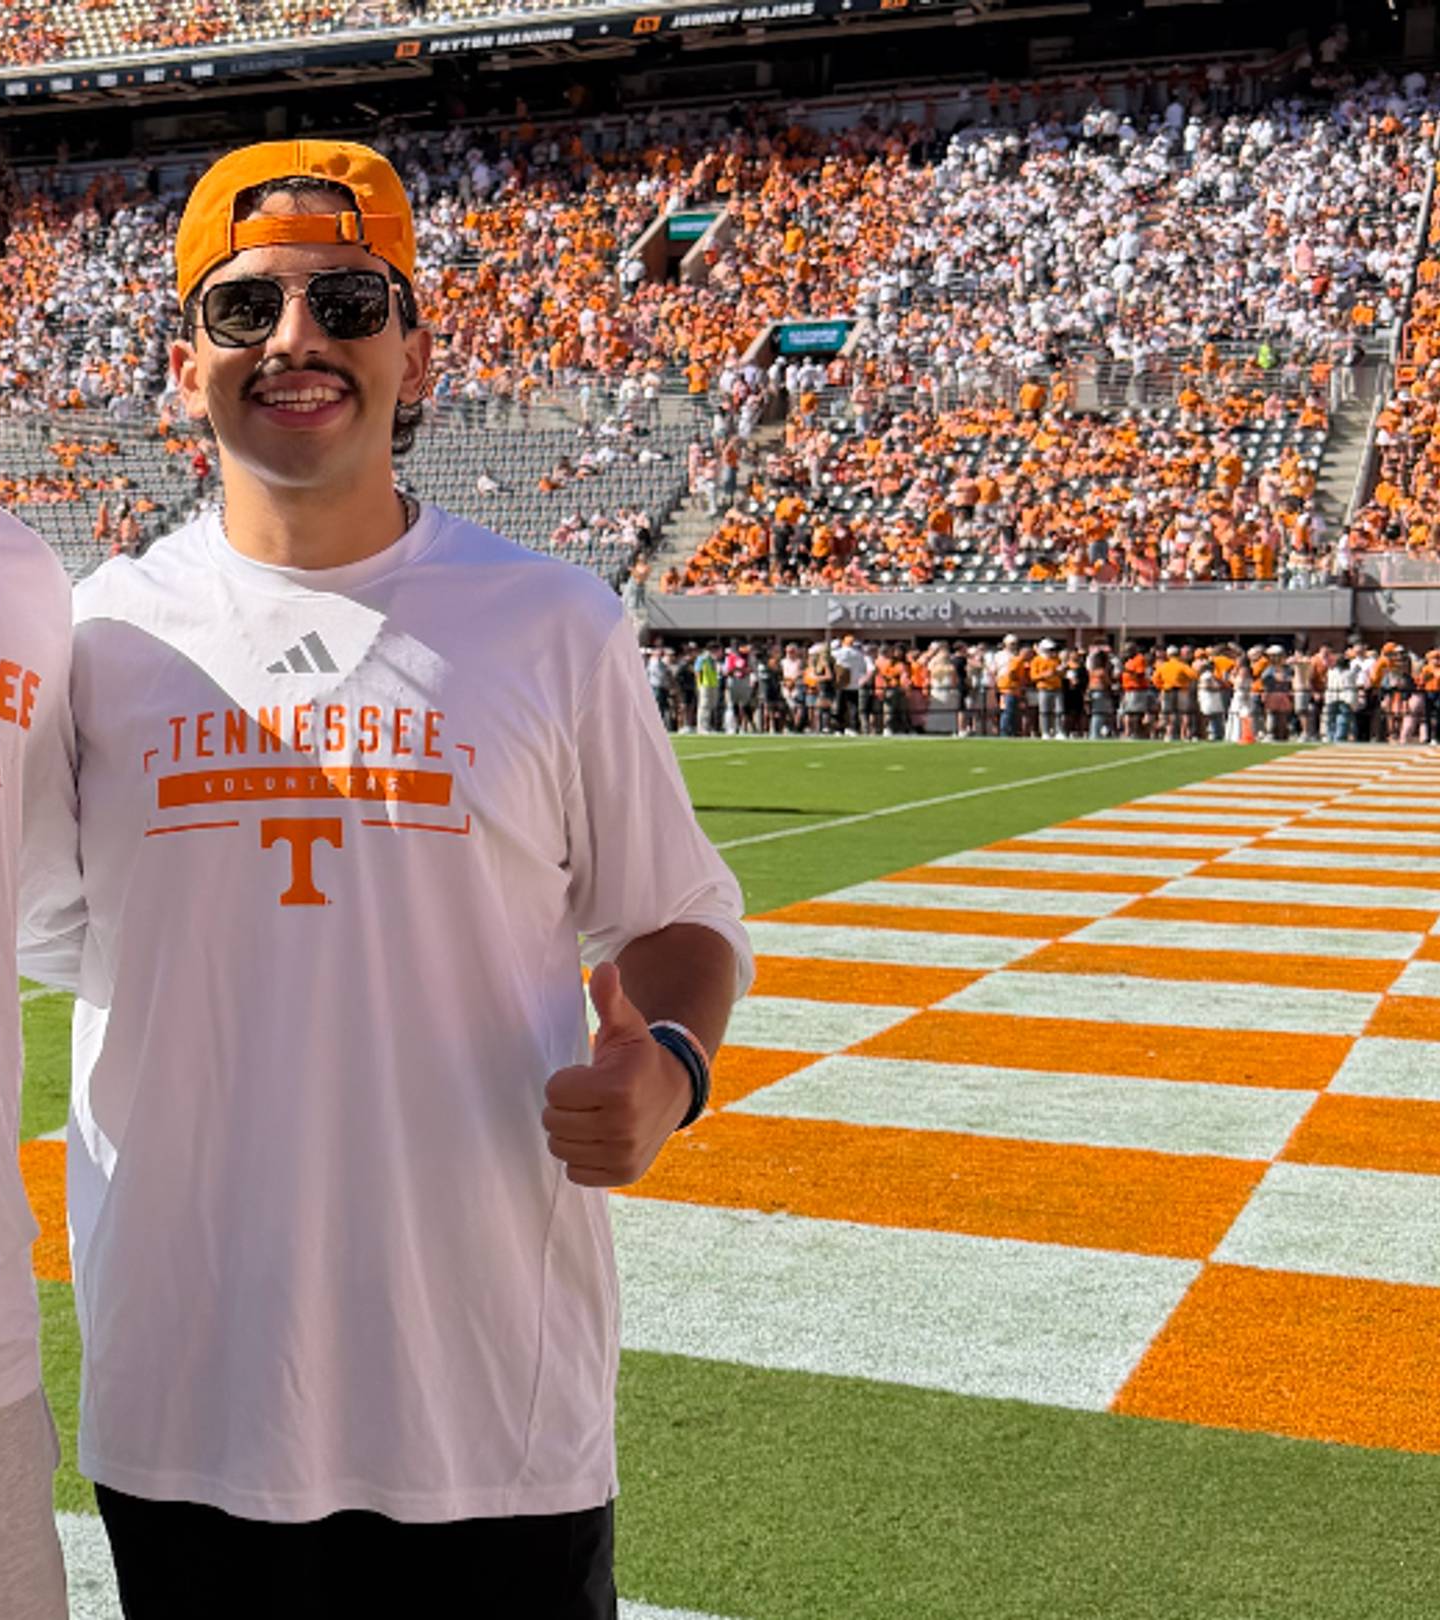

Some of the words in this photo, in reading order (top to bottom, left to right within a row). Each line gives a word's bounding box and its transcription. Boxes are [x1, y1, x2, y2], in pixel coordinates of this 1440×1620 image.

[670, 9, 738, 29] JOHNNY
[741, 2, 815, 21] MAJORS
[429, 34, 494, 53] PEYTON
[496, 26, 574, 46] MANNING
[848, 599, 952, 621] Transcard
[168, 703, 446, 762] TENNESSEE
[204, 776, 399, 793] VOLUNTEERS
[260, 817, 343, 906] T
